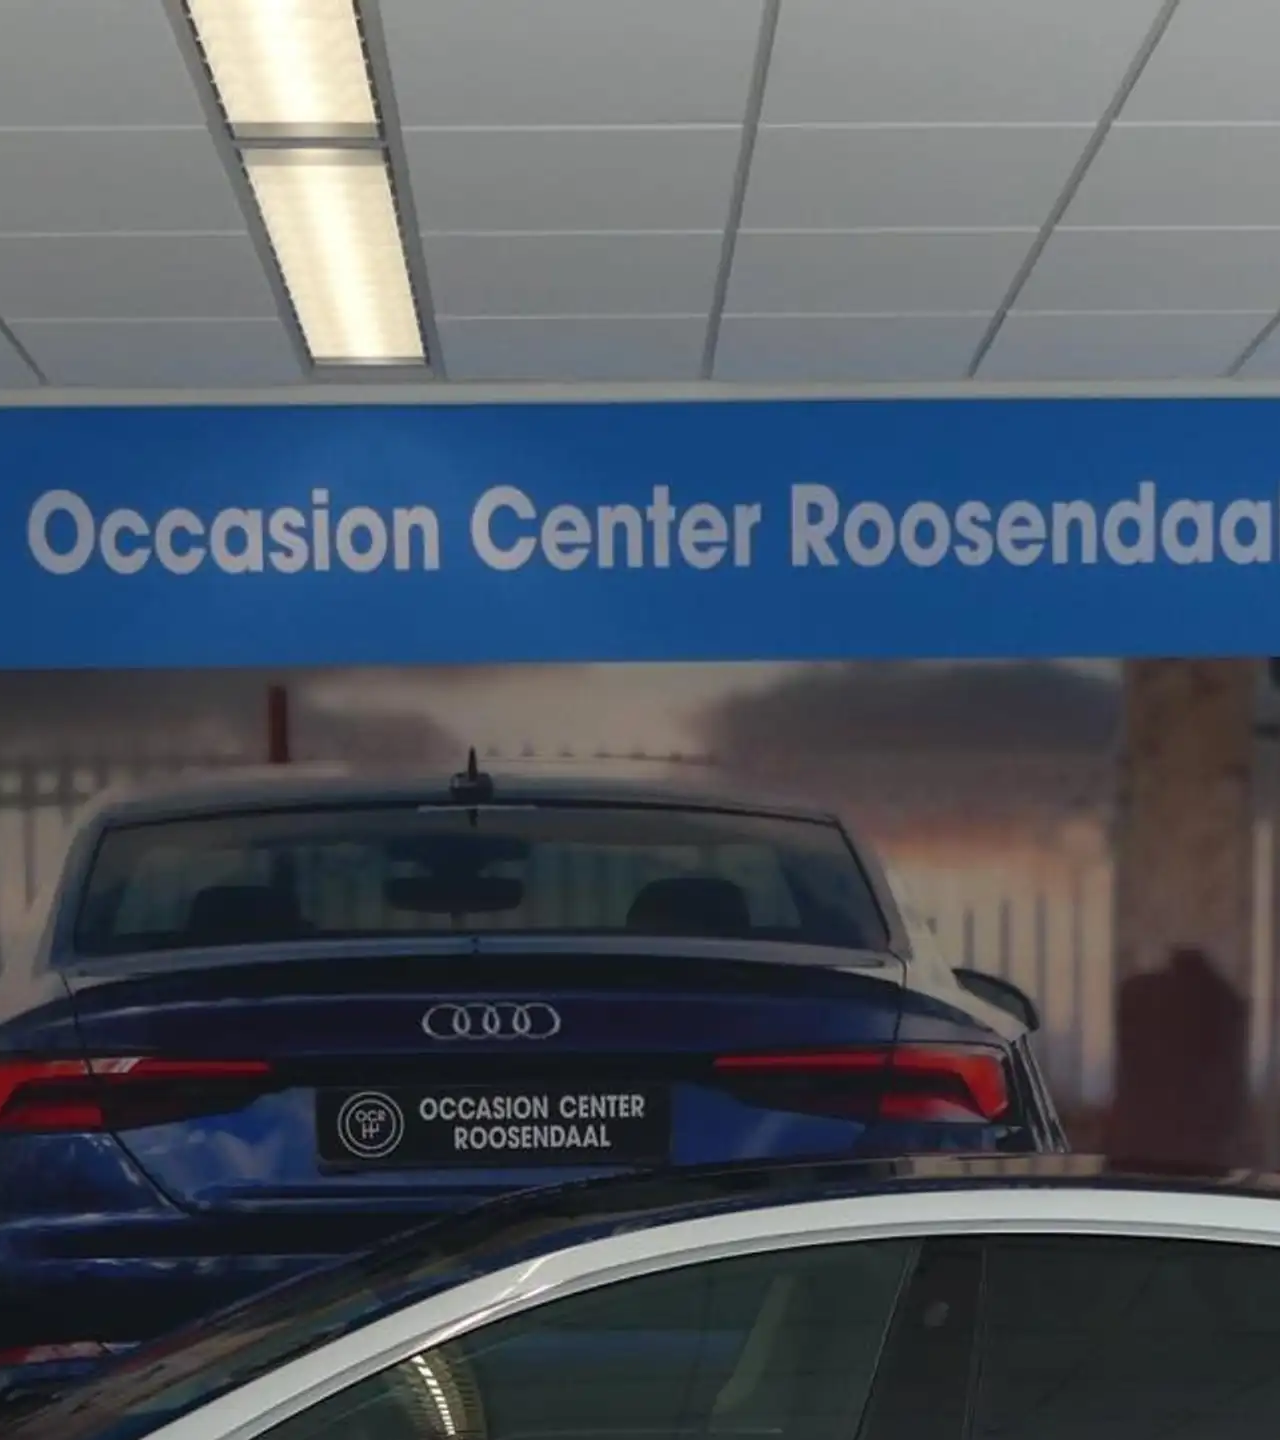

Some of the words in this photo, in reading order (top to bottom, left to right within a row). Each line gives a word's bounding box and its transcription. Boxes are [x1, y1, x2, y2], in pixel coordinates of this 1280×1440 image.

[27, 487, 440, 575] Occasion
[469, 485, 761, 571] Center
[355, 1109, 387, 1123] OCR
[420, 1096, 549, 1121] OCCASION
[559, 1094, 645, 1119] CENTER
[454, 1124, 612, 1150] ROOSENDAAL
